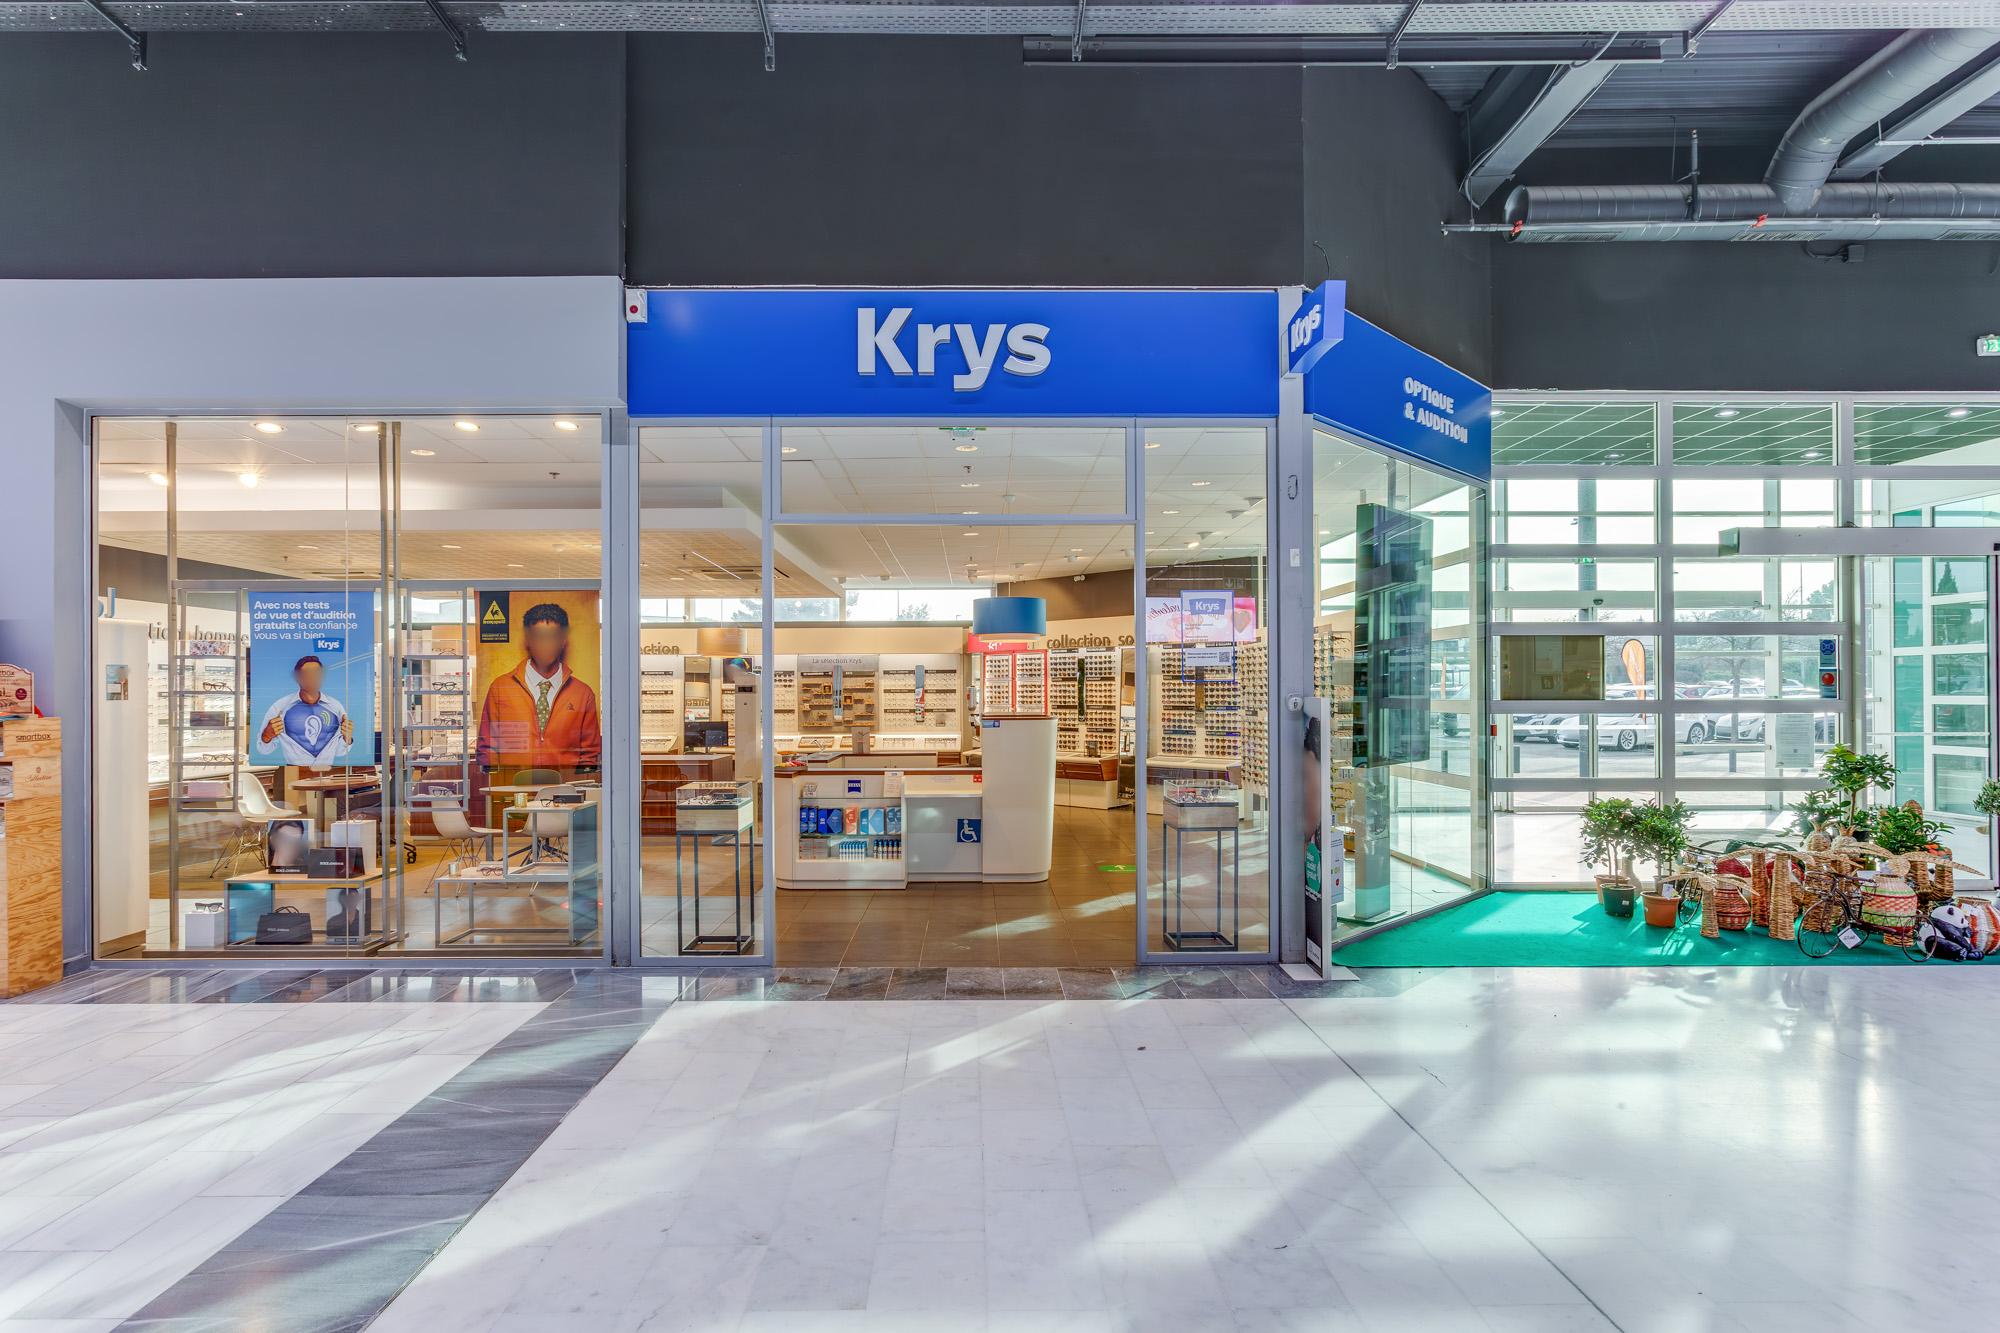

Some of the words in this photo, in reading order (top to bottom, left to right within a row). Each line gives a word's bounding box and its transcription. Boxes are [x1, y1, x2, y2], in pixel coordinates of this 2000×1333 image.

[1290, 303, 1322, 353] Krys
[857, 307, 1052, 392] Krys
[1403, 376, 1455, 415] OPTIQUE
[1404, 402, 1415, 421] &
[1416, 407, 1468, 444] AUDITION
[254, 601, 280, 610] Avec
[282, 602, 301, 610] nos
[303, 602, 330, 610] tests
[1195, 601, 1220, 612] Krys
[254, 611, 267, 620] de
[269, 612, 289, 620] vue
[291, 612, 302, 620] et
[304, 611, 356, 620] d'audition
[298, 621, 307, 630] la
[309, 621, 358, 630] confiance
[254, 632, 278, 640] vous
[279, 632, 291, 640] va
[292, 631, 301, 640] si
[303, 631, 325, 640] bien
[1047, 632, 1111, 649] collection
[317, 639, 340, 650] Krys
